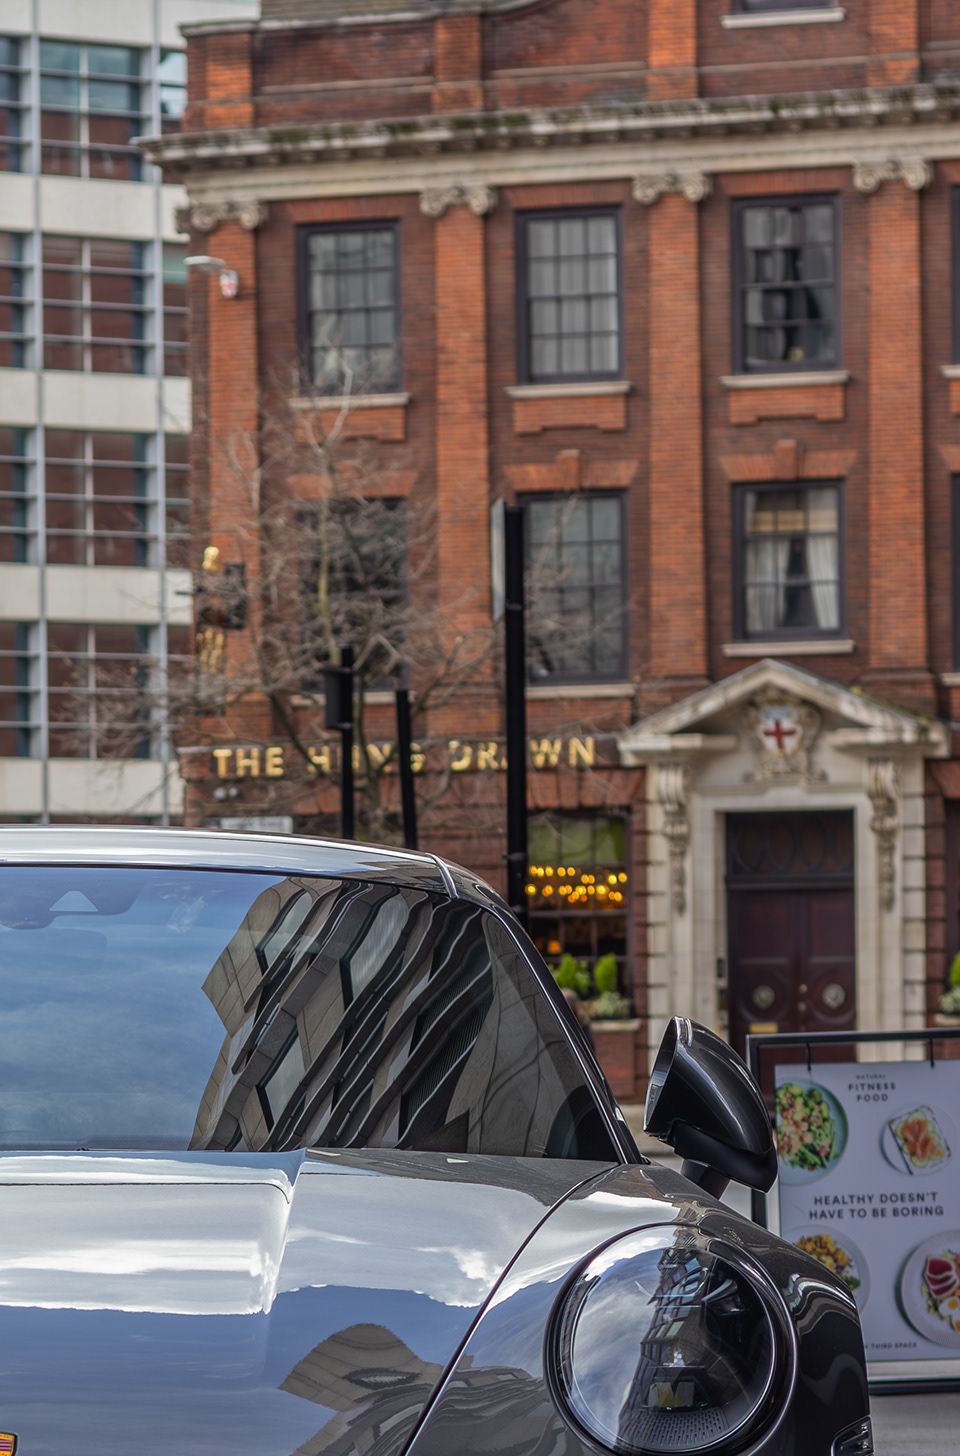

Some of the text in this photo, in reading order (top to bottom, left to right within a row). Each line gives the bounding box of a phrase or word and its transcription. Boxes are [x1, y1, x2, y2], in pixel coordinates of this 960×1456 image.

[213, 747, 284, 778] THE
[448, 736, 595, 771] DRWN
[848, 1082, 896, 1092] FITNESS
[856, 1093, 888, 1102] FOOD
[814, 1191, 939, 1206] HEALTHY DOESN'T
[809, 1205, 944, 1220] HAVE TO BE BORING
[895, 1341, 917, 1349] SPACE
